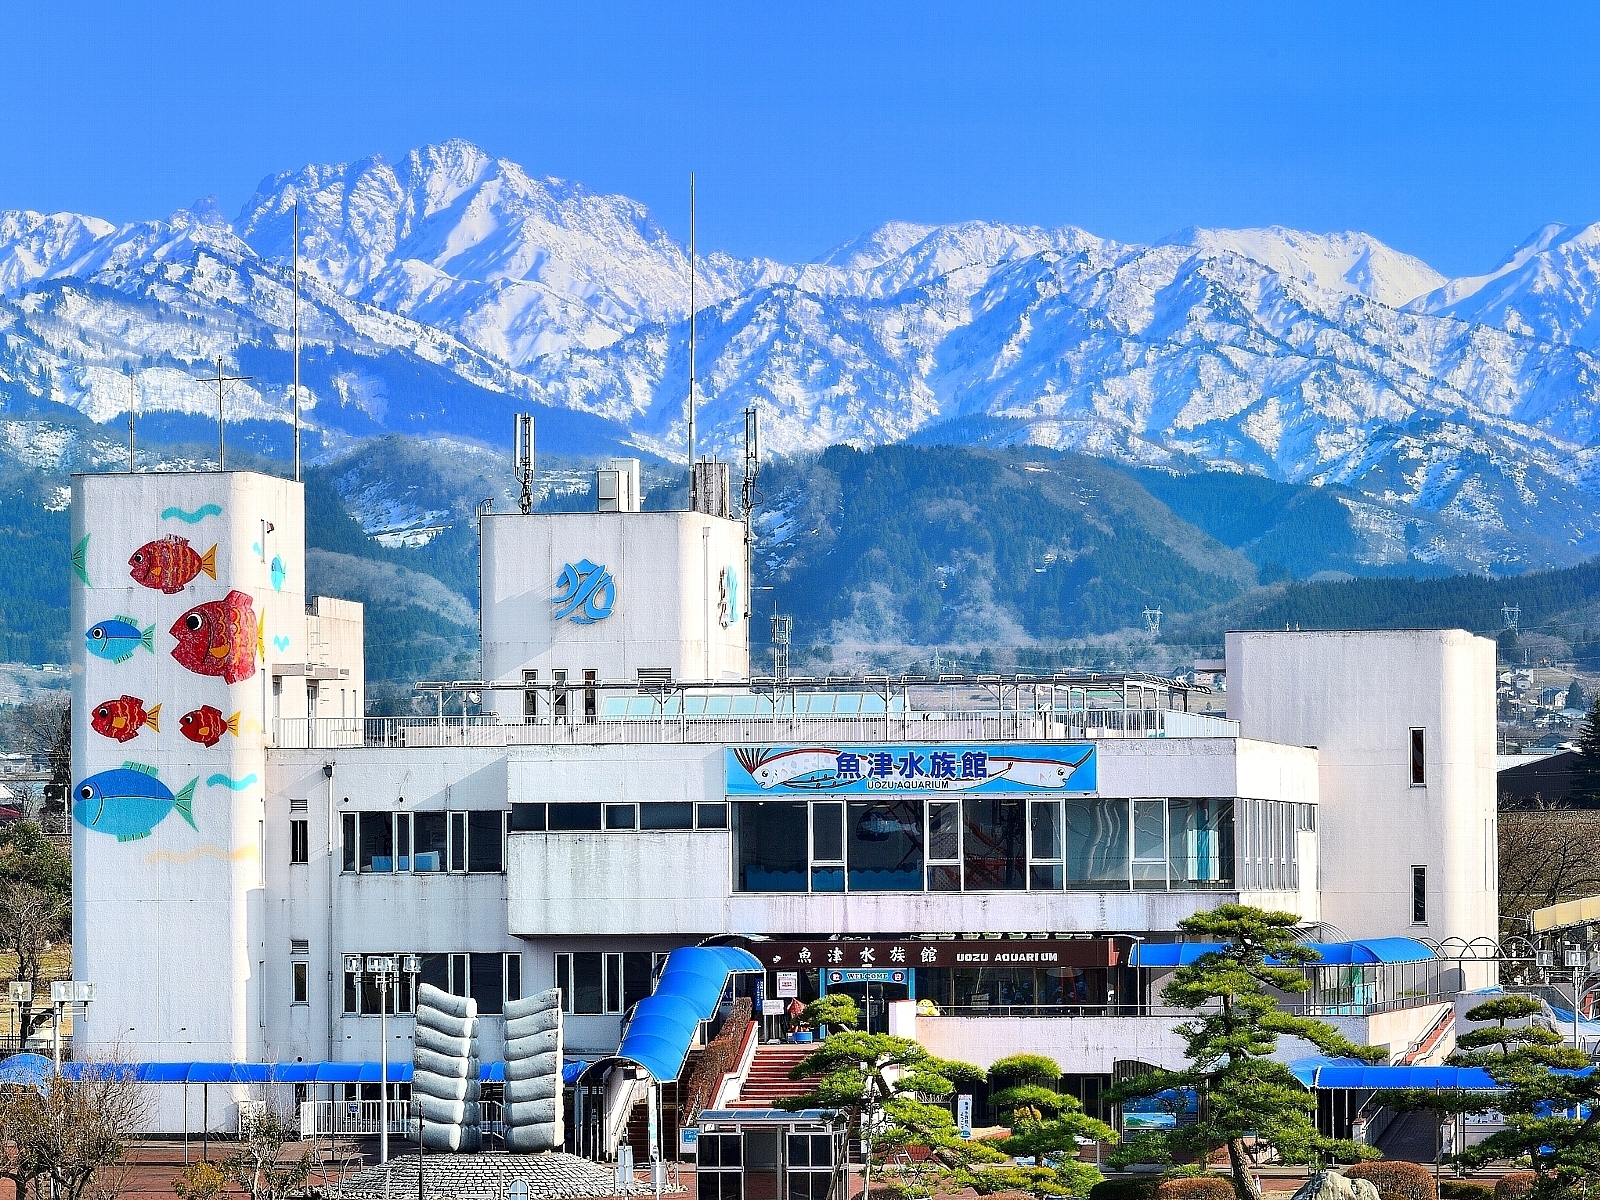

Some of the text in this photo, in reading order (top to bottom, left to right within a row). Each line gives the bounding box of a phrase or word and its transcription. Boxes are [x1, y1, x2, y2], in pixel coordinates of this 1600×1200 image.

[835, 751, 988, 779] 魚津水族館
[867, 780, 949, 790] UOZU AQUARIUM
[797, 946, 938, 964] 魚津水族館
[956, 952, 1058, 962] UOZU AQUARIUM
[846, 972, 889, 981] WELCOME
